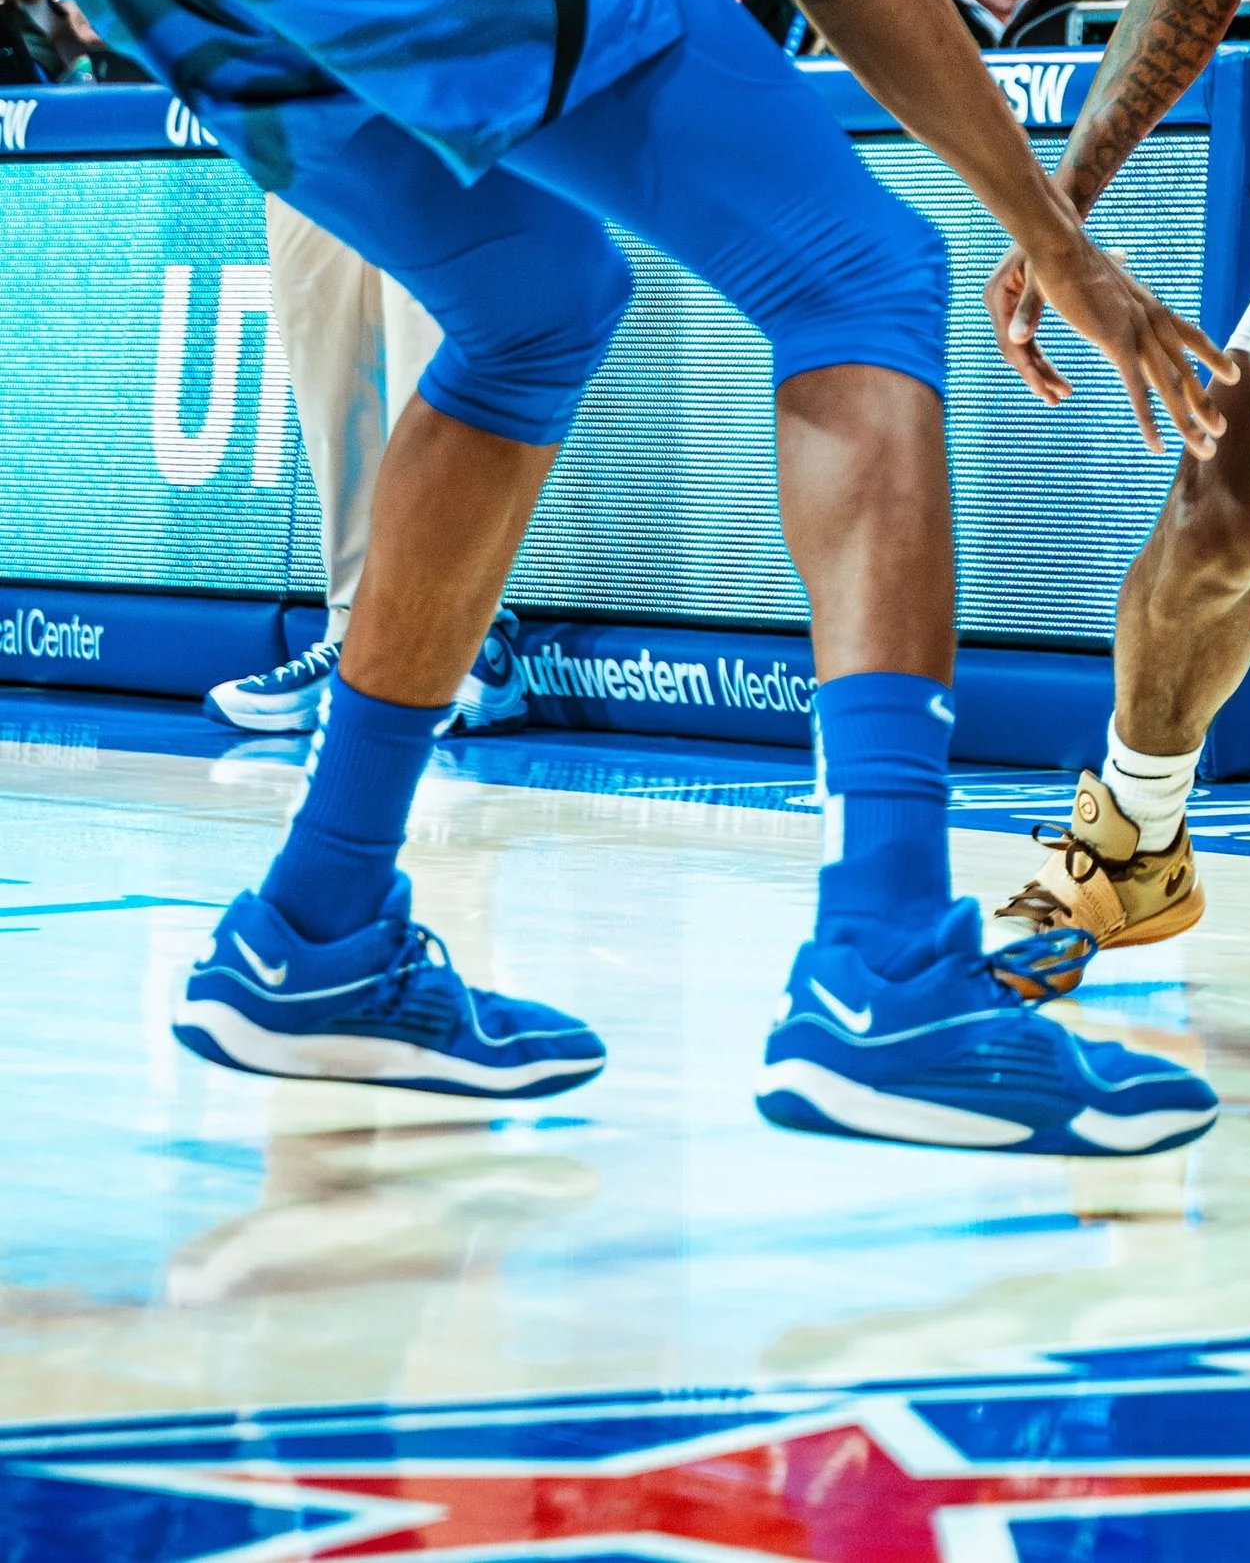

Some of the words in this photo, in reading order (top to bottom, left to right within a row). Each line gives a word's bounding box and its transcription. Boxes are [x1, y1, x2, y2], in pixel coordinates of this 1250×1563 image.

[985, 63, 1076, 124] SW
[0, 608, 23, 655] al
[26, 608, 105, 660] Center
